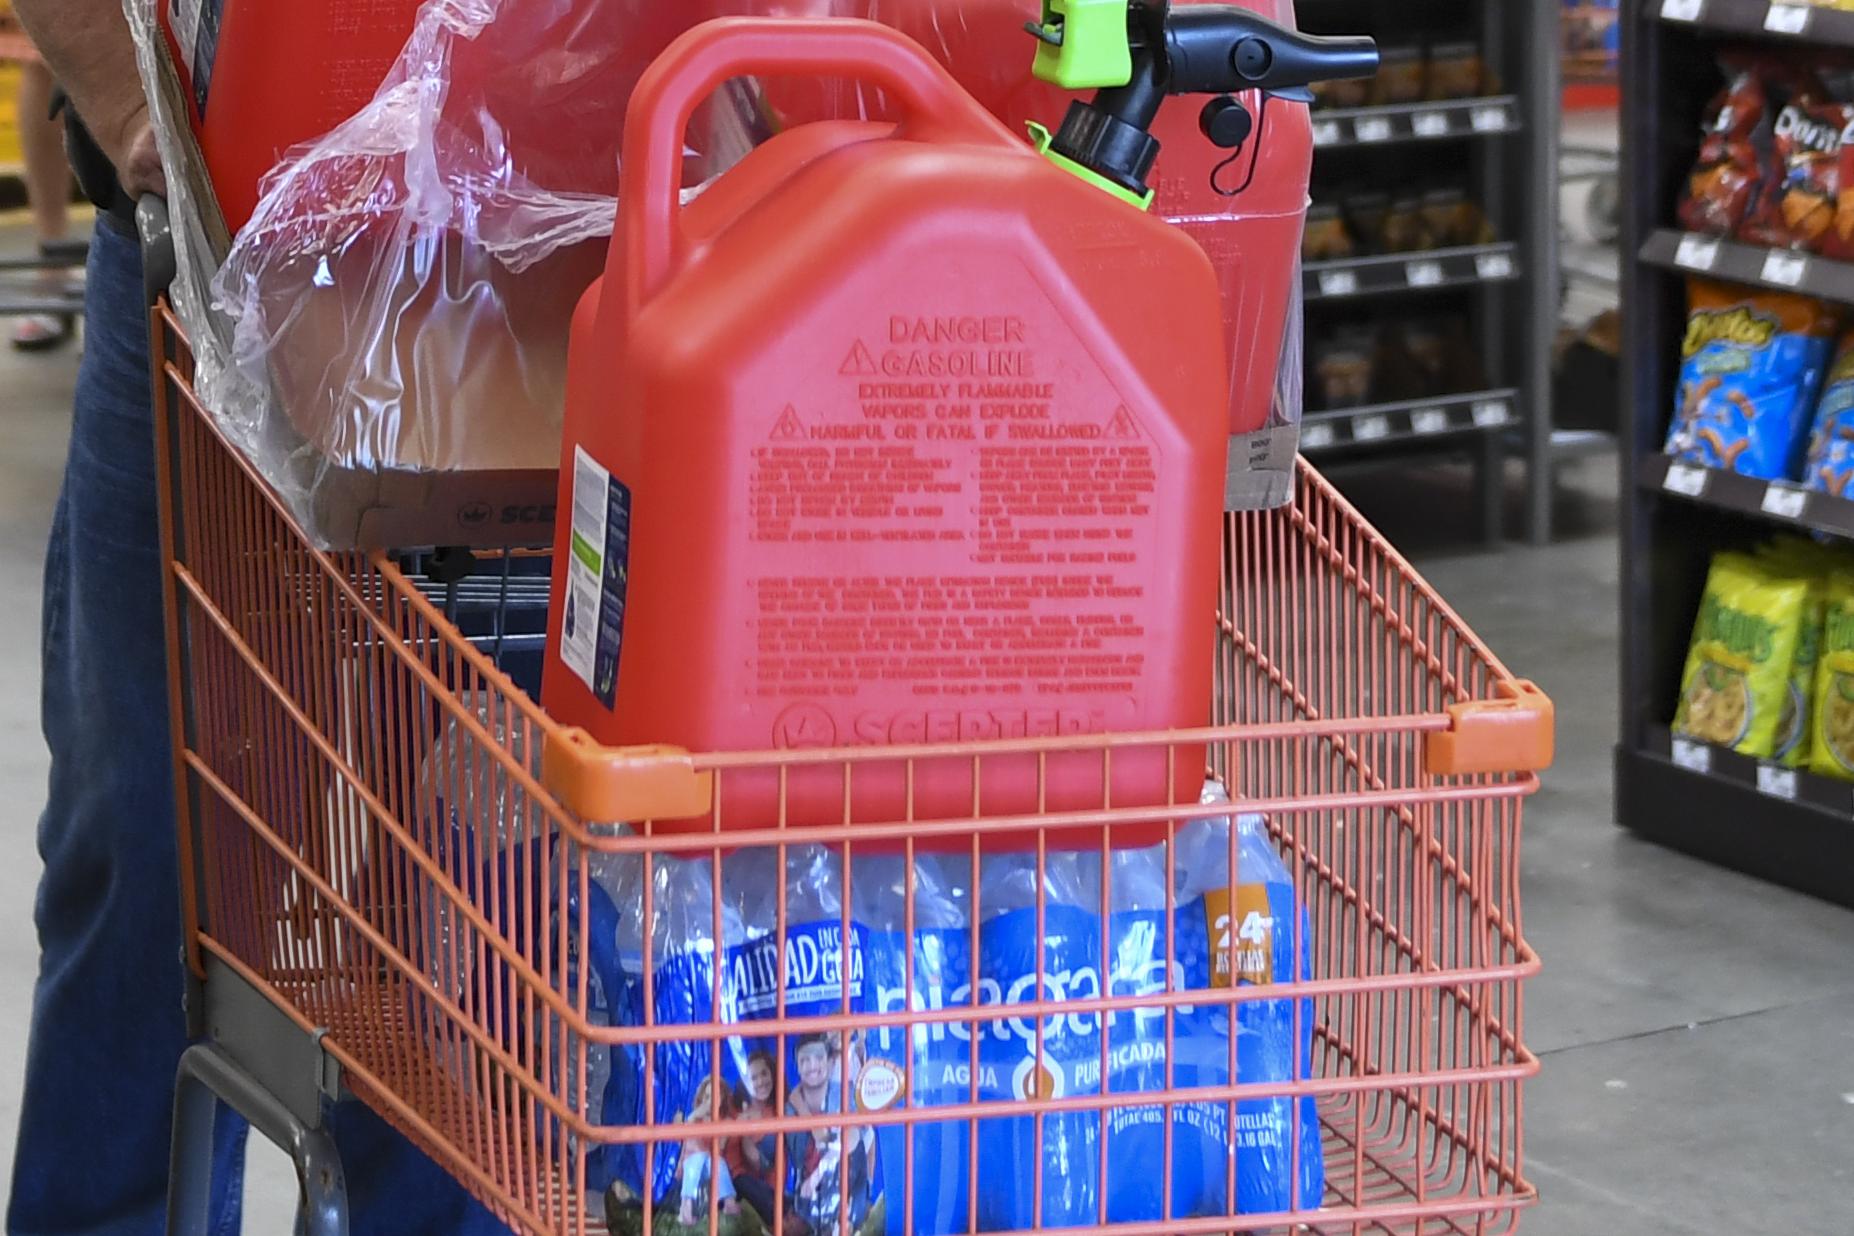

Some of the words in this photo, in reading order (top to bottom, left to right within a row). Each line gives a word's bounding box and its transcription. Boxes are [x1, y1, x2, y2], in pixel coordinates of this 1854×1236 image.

[889, 316, 1025, 344] DANGER
[881, 349, 1035, 377] GASOLINE
[857, 382, 951, 400] EXTREMELY
[957, 382, 1054, 400] FLAMMABLE
[861, 404, 927, 420] VAPORS
[934, 404, 972, 420] CAN
[979, 403, 1051, 420] EXPLODE
[810, 424, 885, 441] HARMFUL
[893, 424, 919, 441] OR
[926, 424, 977, 441] FATAL
[984, 424, 999, 440] IF
[1008, 423, 1102, 440] SWALLOWED
[1215, 910, 1268, 949] 24
[733, 934, 819, 999] ALIDAD
[877, 958, 1195, 1057] niagara
